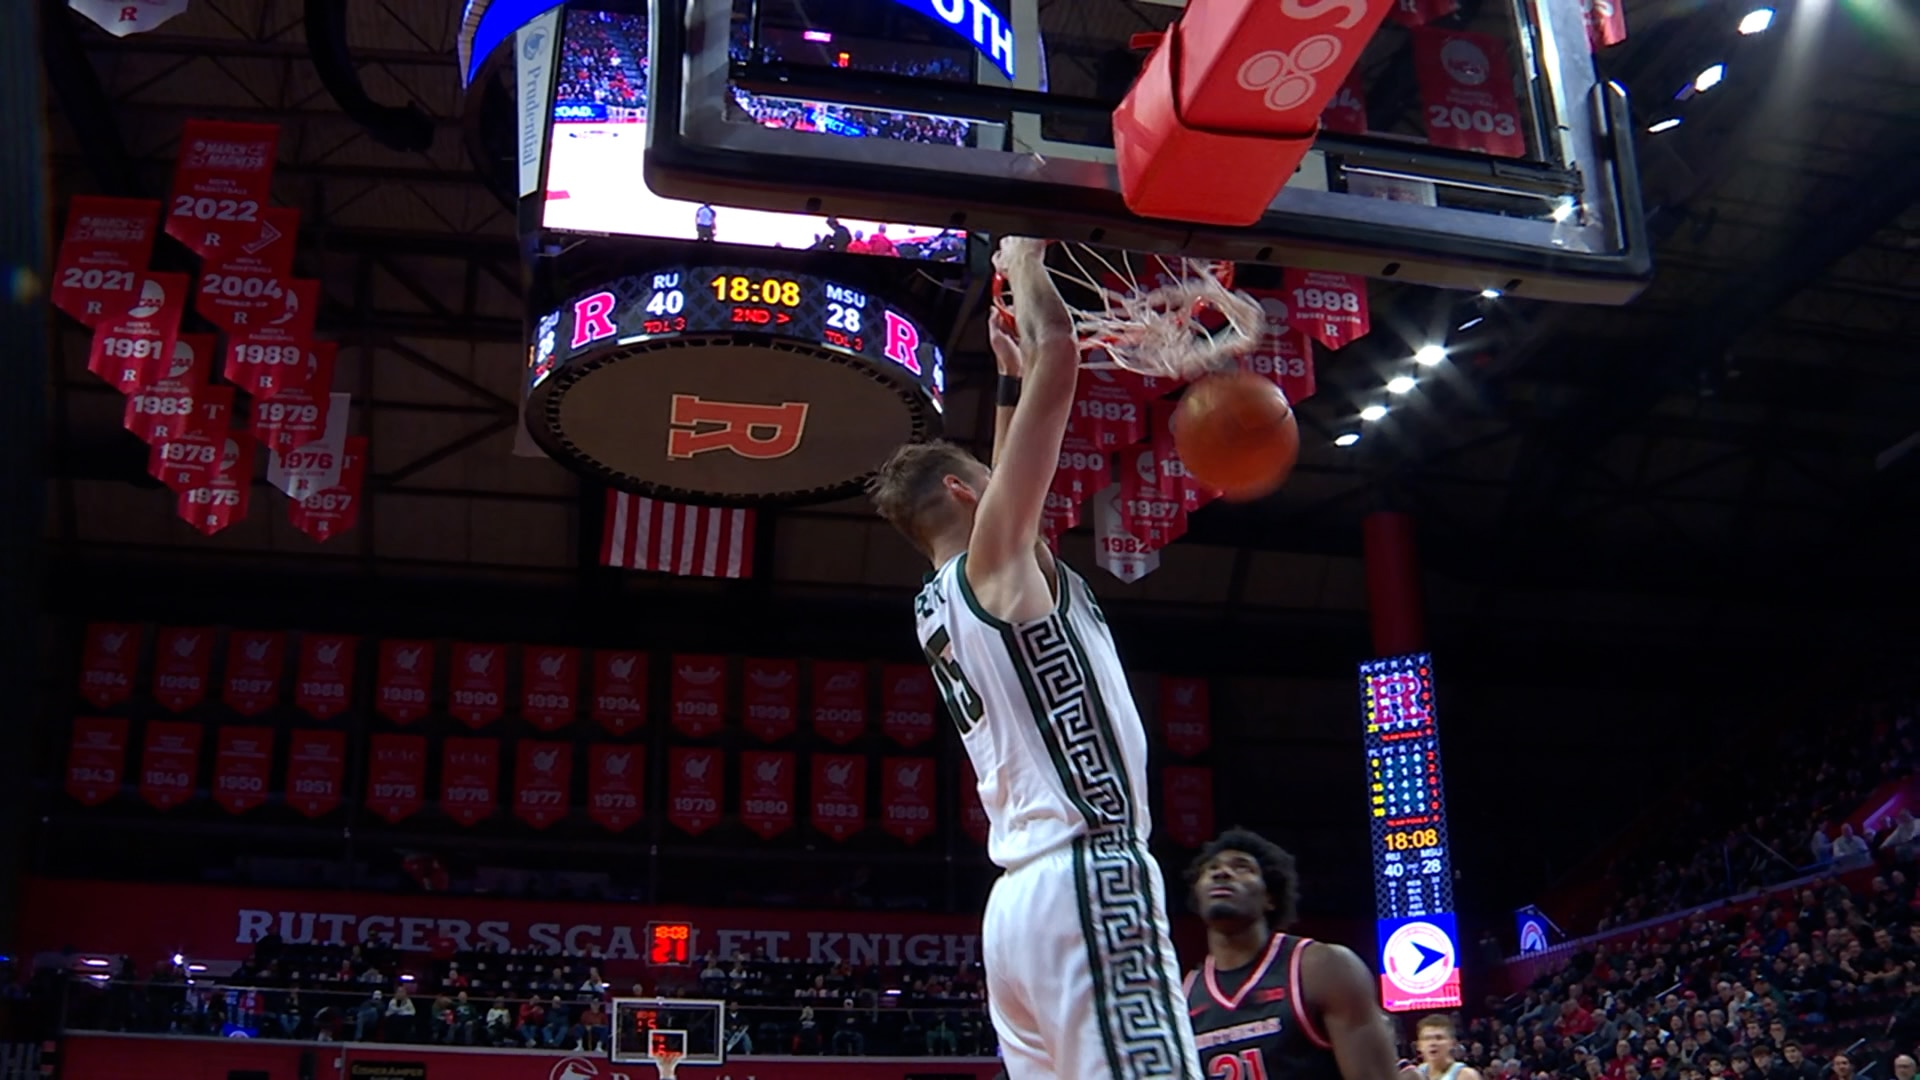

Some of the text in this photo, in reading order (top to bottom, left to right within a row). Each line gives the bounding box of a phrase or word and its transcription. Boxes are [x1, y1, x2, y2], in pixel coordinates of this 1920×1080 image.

[523, 66, 542, 166] Prudential
[1429, 105, 1516, 136] 2003
[174, 195, 258, 222] 2022
[205, 232, 221, 247] R
[62, 267, 135, 291] 2021
[202, 273, 283, 299] 2004
[653, 273, 679, 289] RU
[712, 276, 800, 307] 18:08
[826, 284, 866, 308] MSU
[1293, 288, 1359, 313] 1998
[87, 301, 102, 314] R
[646, 290, 684, 315] 40
[233, 311, 248, 325] R
[571, 291, 617, 349] R
[732, 308, 771, 325] 2ND
[826, 303, 861, 333] 28
[1325, 323, 1339, 337] R
[103, 337, 163, 360] 1991
[884, 310, 921, 376] R
[235, 344, 300, 366] 1989
[123, 369, 137, 382] R
[1244, 354, 1306, 377] 1993
[260, 375, 273, 388] R
[134, 395, 194, 415] 1983
[257, 402, 319, 423] 1979
[1076, 400, 1137, 422] 1992
[154, 425, 168, 437] R
[667, 394, 809, 460] R
[280, 432, 292, 445] R
[1103, 432, 1116, 444] R
[159, 442, 216, 463] 1978
[280, 453, 333, 469] 1976
[1058, 451, 1104, 471] 990
[1160, 459, 1193, 478] 19
[187, 488, 240, 506] 1975
[1185, 489, 1197, 500] R
[1127, 501, 1180, 518] 1987
[1101, 537, 1151, 554] 1982
[1122, 564, 1135, 574] R
[1384, 829, 1438, 850] 18:08
[1385, 852, 1401, 862] RU
[1384, 859, 1442, 877] 40 28
[235, 909, 511, 953] RUTGERS
[527, 922, 791, 963] SCALET
